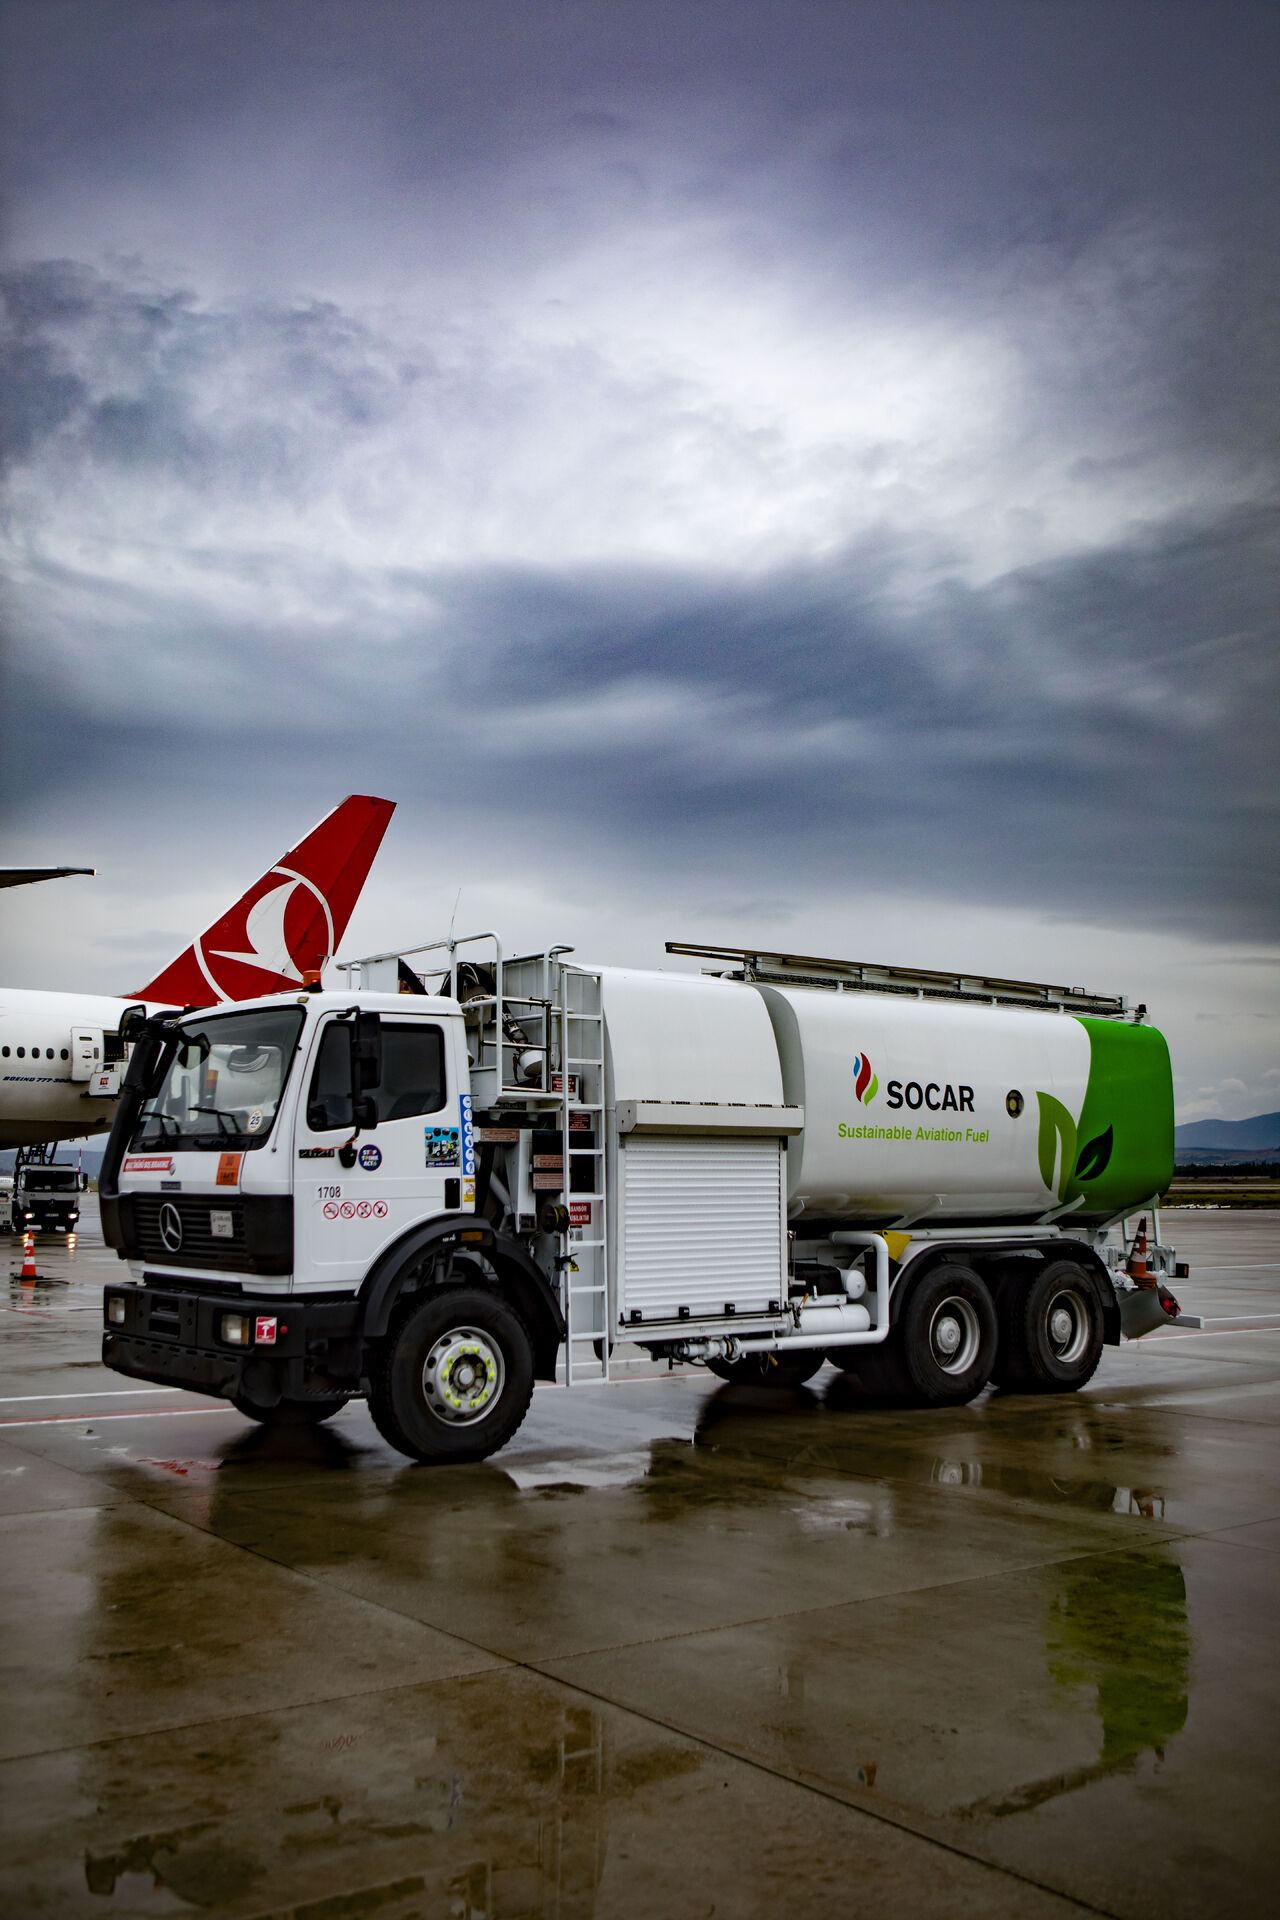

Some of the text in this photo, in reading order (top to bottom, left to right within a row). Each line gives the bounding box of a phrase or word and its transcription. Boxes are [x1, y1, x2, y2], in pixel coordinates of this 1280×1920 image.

[886, 1080, 975, 1112] SOCAR
[838, 1123, 990, 1143] Sustainable Aviation Fuel
[318, 1186, 341, 1198] 1708
